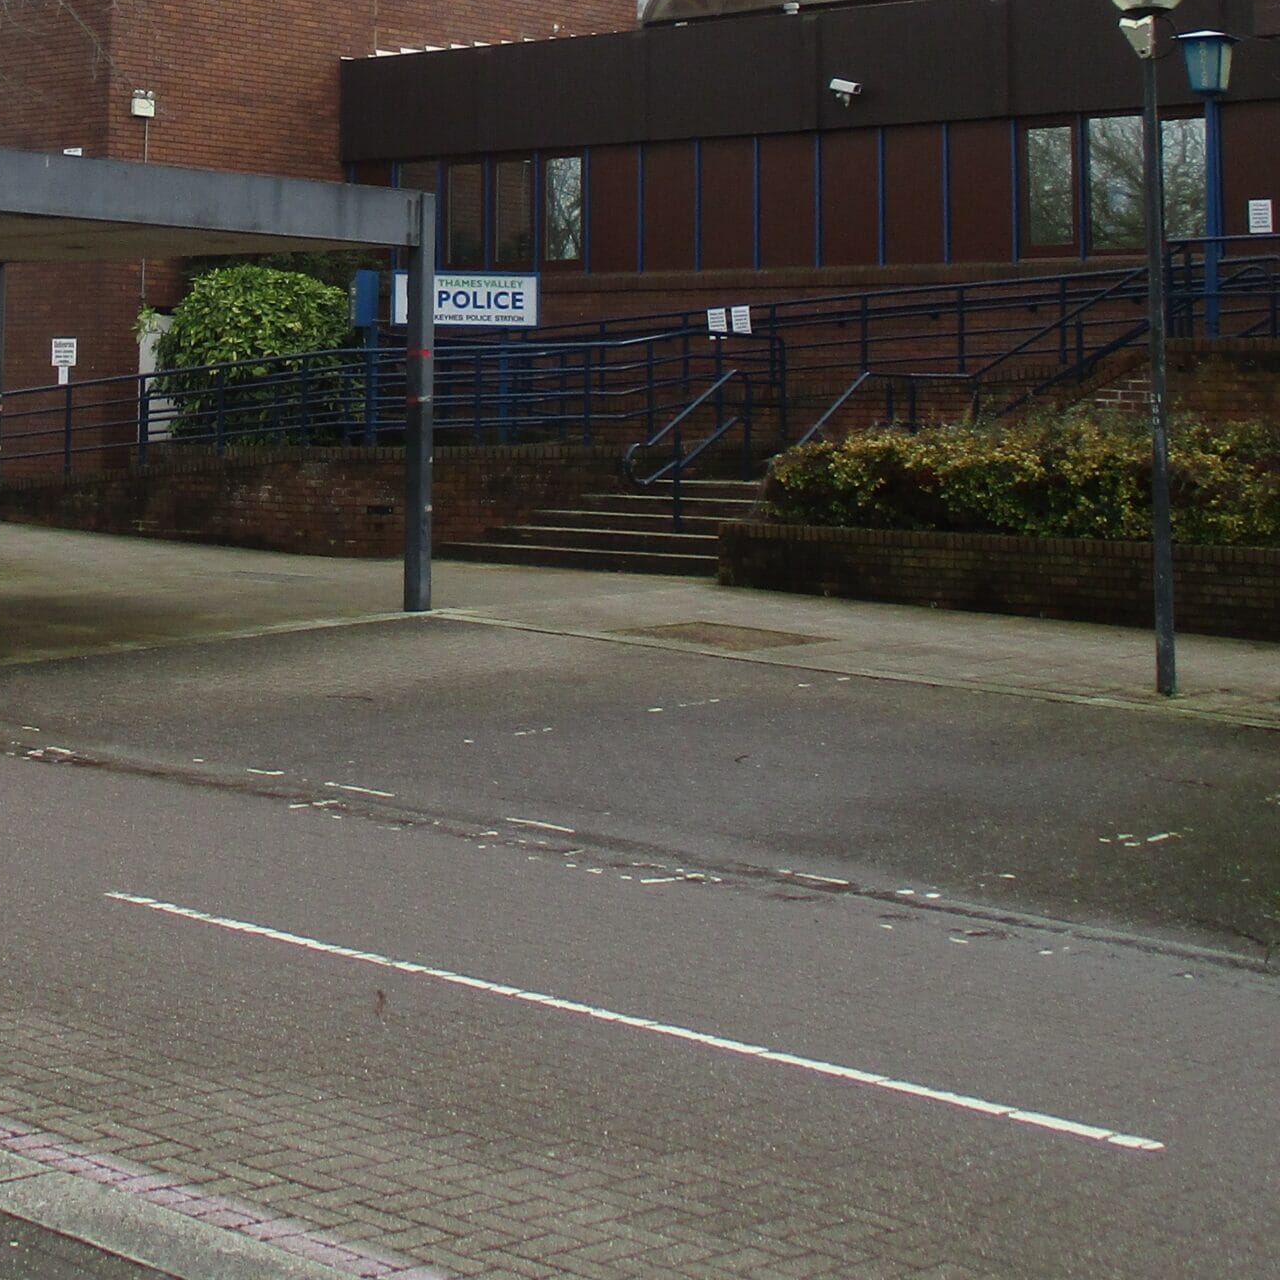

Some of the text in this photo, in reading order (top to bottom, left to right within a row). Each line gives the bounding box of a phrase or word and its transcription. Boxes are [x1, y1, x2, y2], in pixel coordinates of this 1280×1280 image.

[437, 278, 524, 289] THAMES VALLEY
[437, 290, 524, 310] POLICE
[434, 313, 524, 323] KEYNES POLICE STATION
